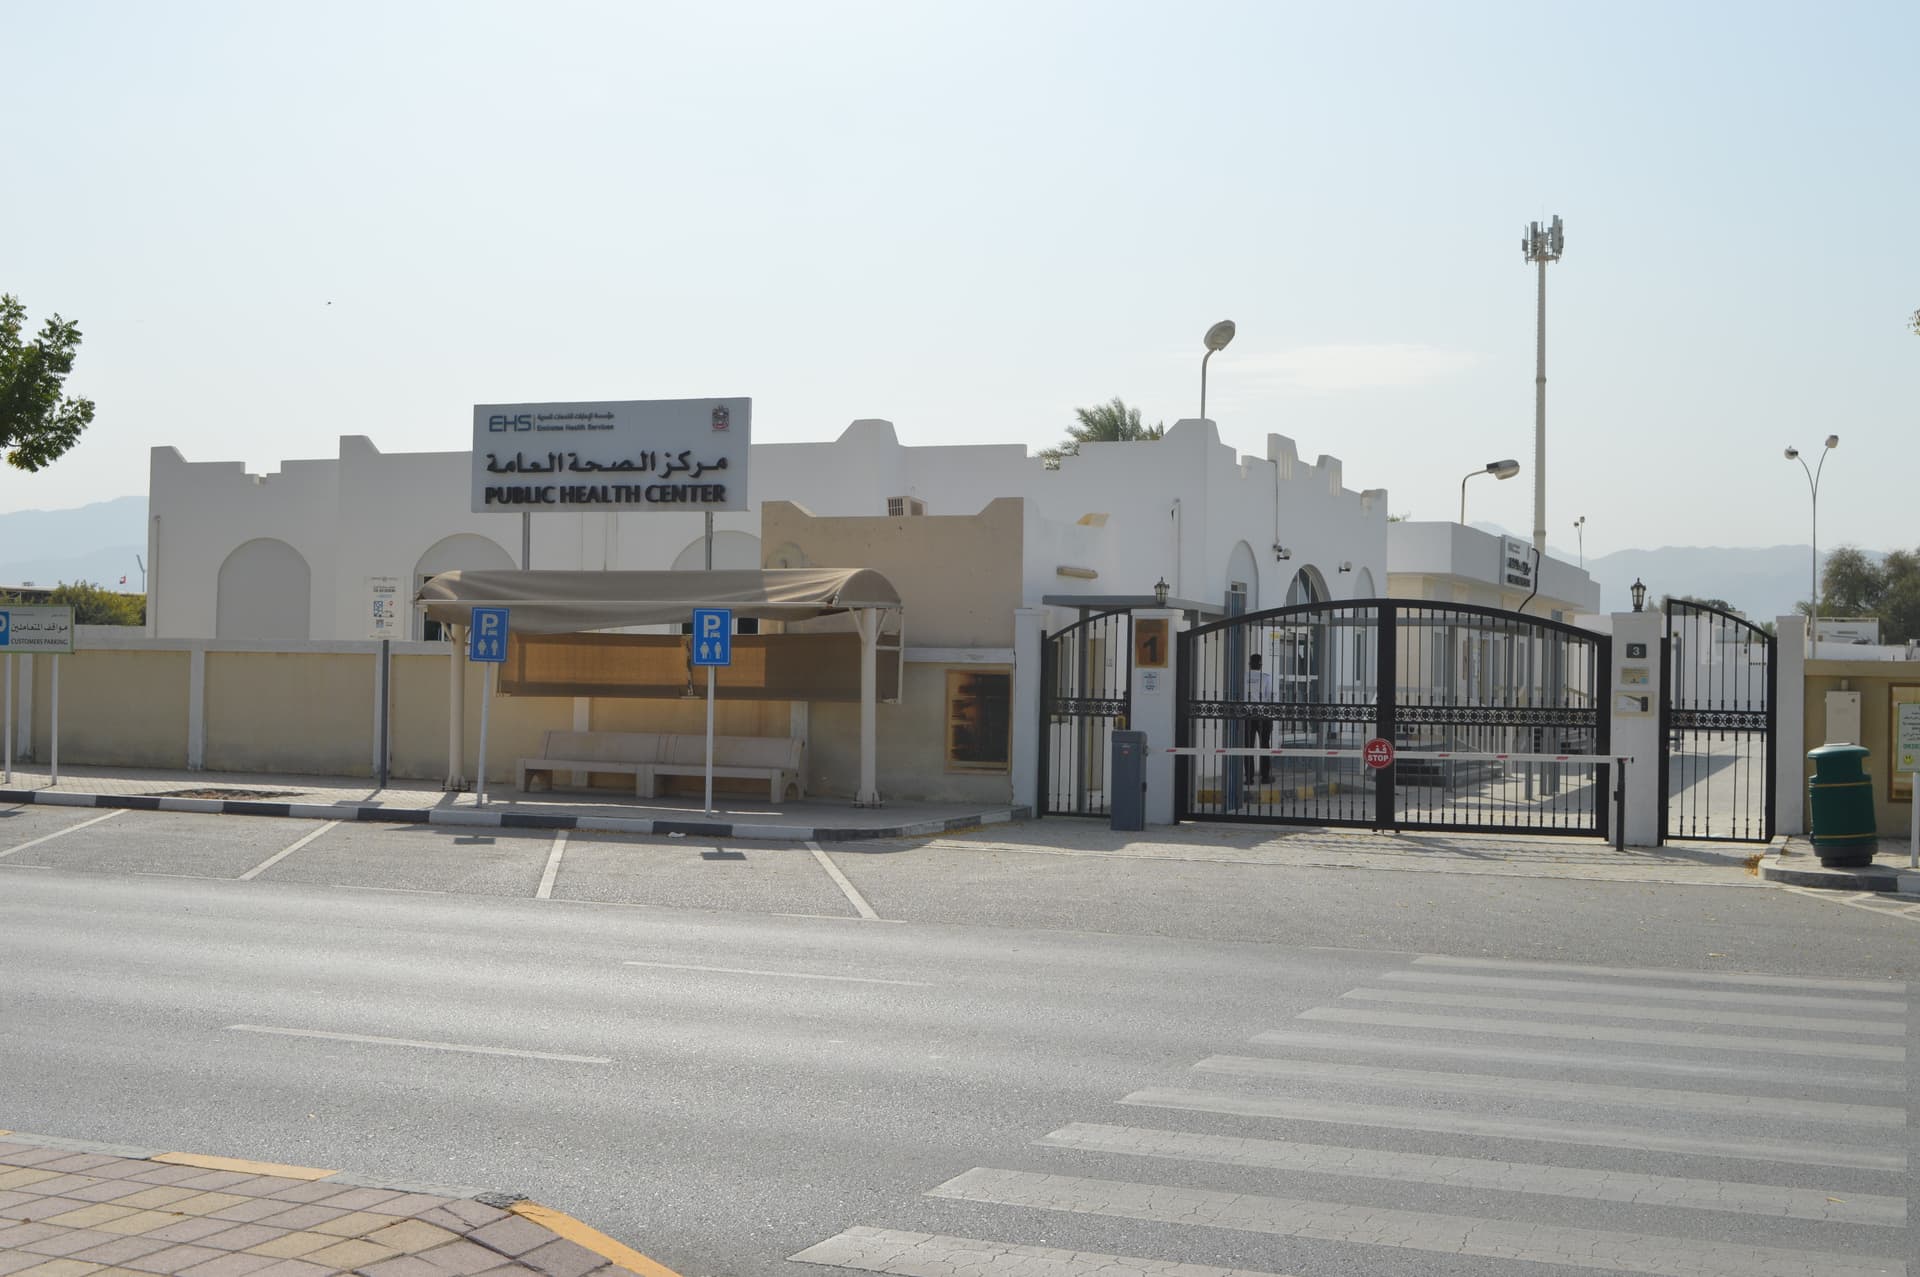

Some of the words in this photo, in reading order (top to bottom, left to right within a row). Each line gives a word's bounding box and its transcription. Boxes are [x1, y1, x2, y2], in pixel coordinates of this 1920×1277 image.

[489, 413, 532, 432] EHS
[565, 423, 586, 431] Health
[587, 423, 615, 431] Services
[486, 451, 563, 474] العامة
[567, 450, 656, 473] الصحة
[658, 450, 729, 479] مركز
[485, 486, 556, 505] PUBLIC
[559, 485, 641, 504] HEALTH
[645, 484, 727, 503] CENTER
[11, 623, 43, 633] المتعاملين
[44, 622, 68, 634] مواقف
[481, 613, 499, 636] P
[703, 614, 721, 638] P
[1143, 635, 1158, 662] 1
[1632, 646, 1641, 656] 3
[1367, 744, 1387, 754] قف
[1367, 754, 1389, 762] STOP
